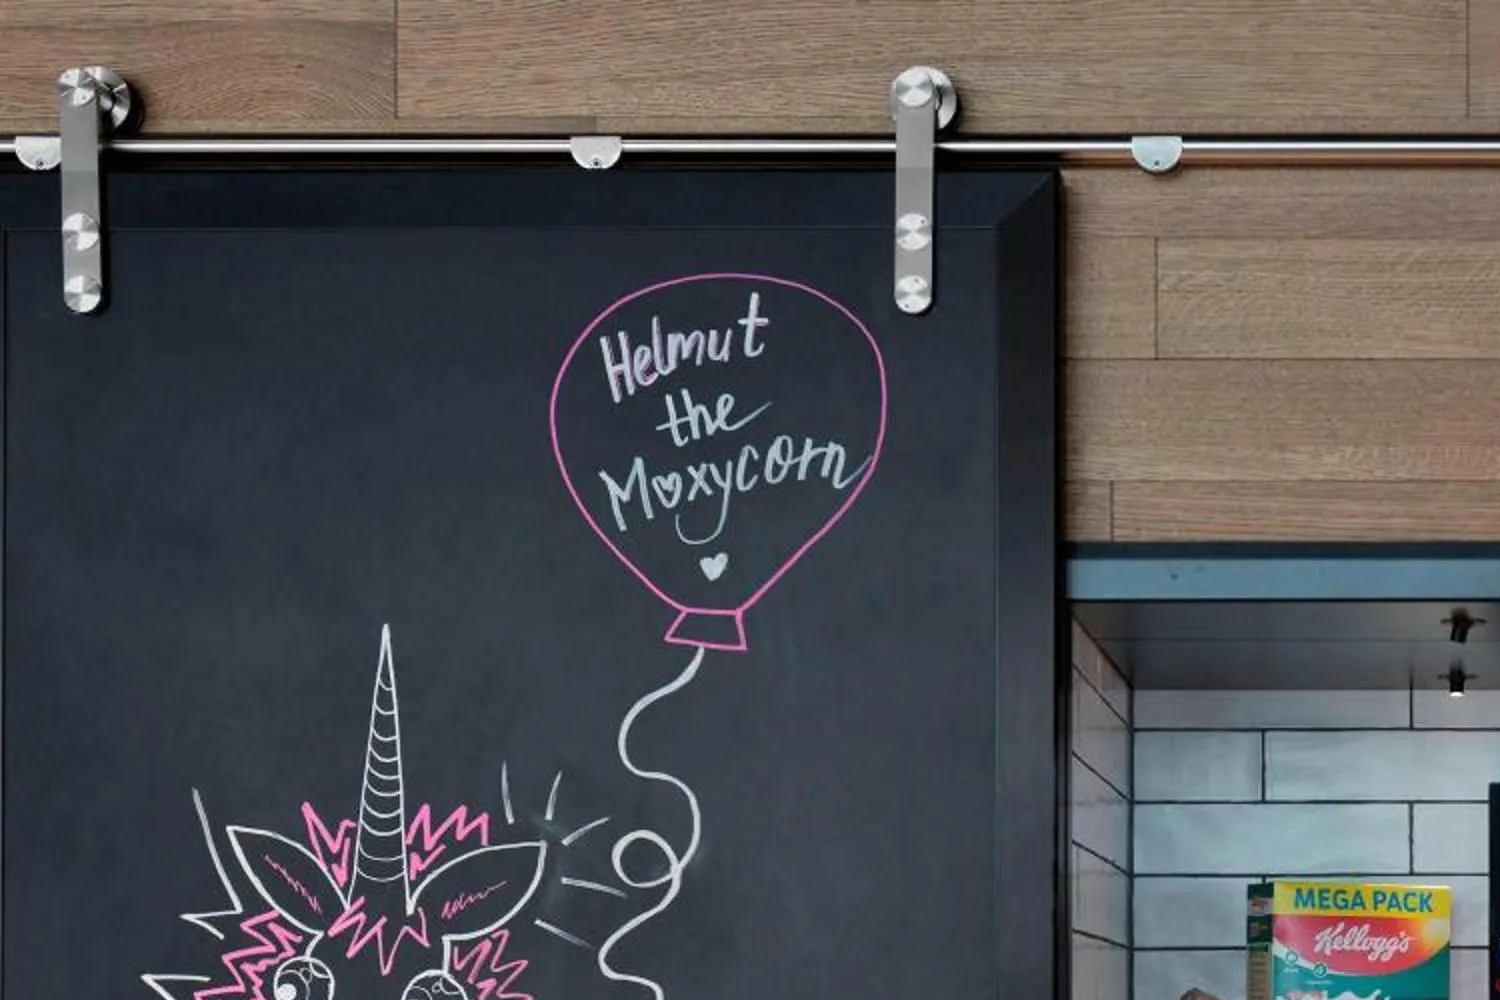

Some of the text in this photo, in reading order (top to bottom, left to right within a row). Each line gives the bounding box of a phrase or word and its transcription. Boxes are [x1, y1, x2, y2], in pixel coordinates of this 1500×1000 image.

[600, 291, 769, 403] Helmut
[656, 388, 772, 447] the
[1294, 888, 1433, 913] MEGA PACK
[1313, 921, 1411, 962] Kellogg's
